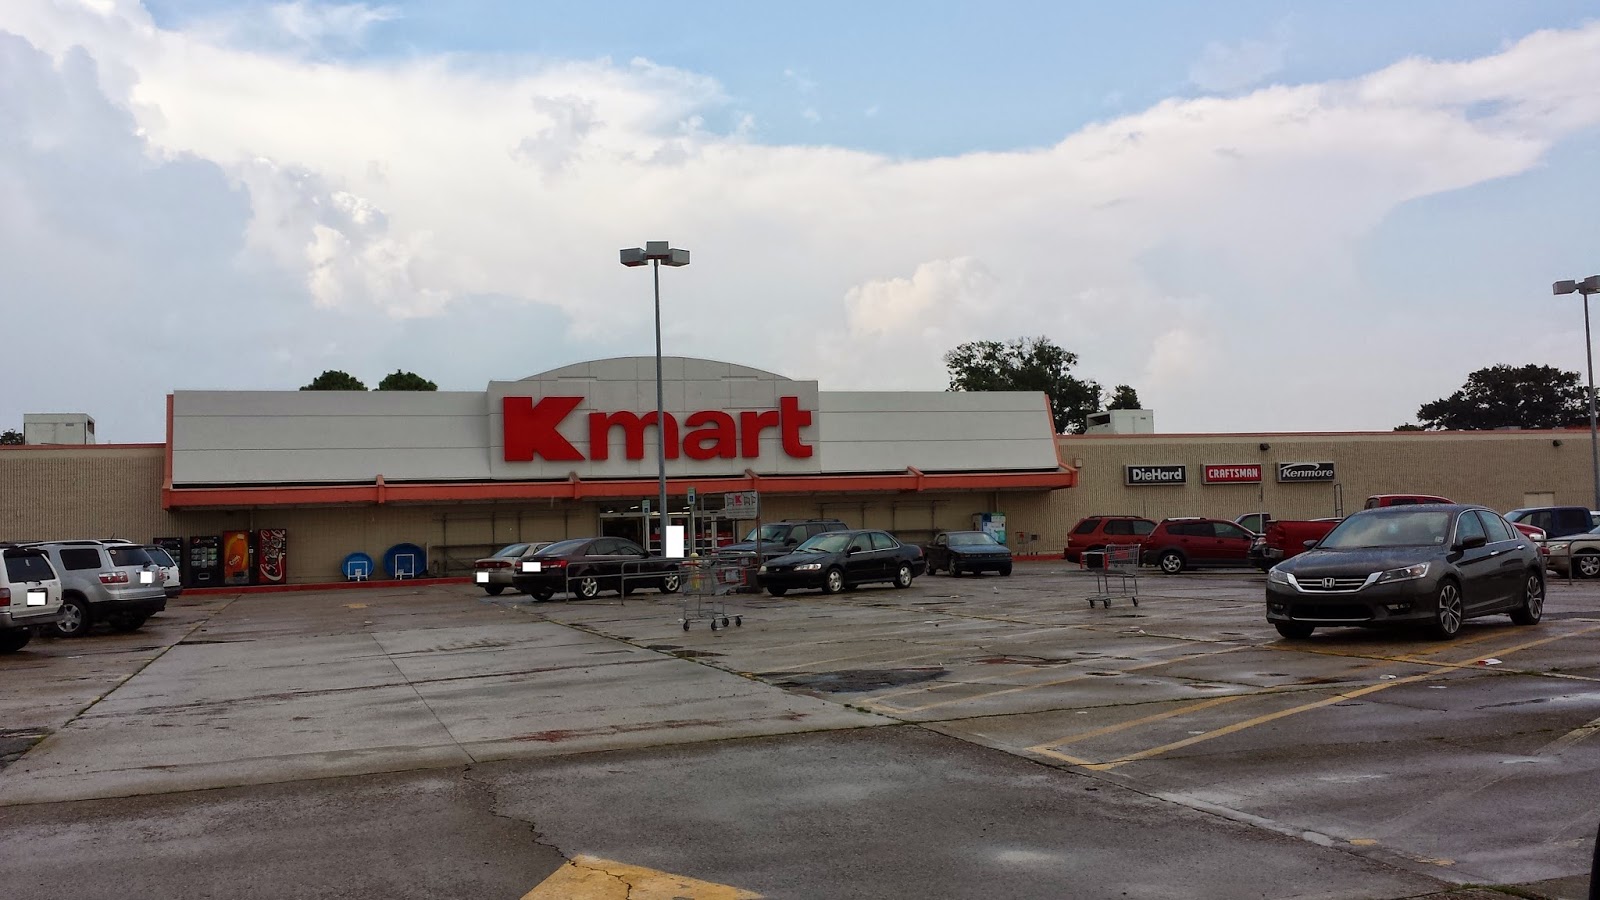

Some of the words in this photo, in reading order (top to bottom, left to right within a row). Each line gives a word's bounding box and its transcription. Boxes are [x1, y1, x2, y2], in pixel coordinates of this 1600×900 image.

[503, 396, 813, 462] Kmart
[1132, 467, 1183, 481] DieHard
[1208, 468, 1259, 479] CRAFTSMAN
[1282, 465, 1334, 479] Kenmore
